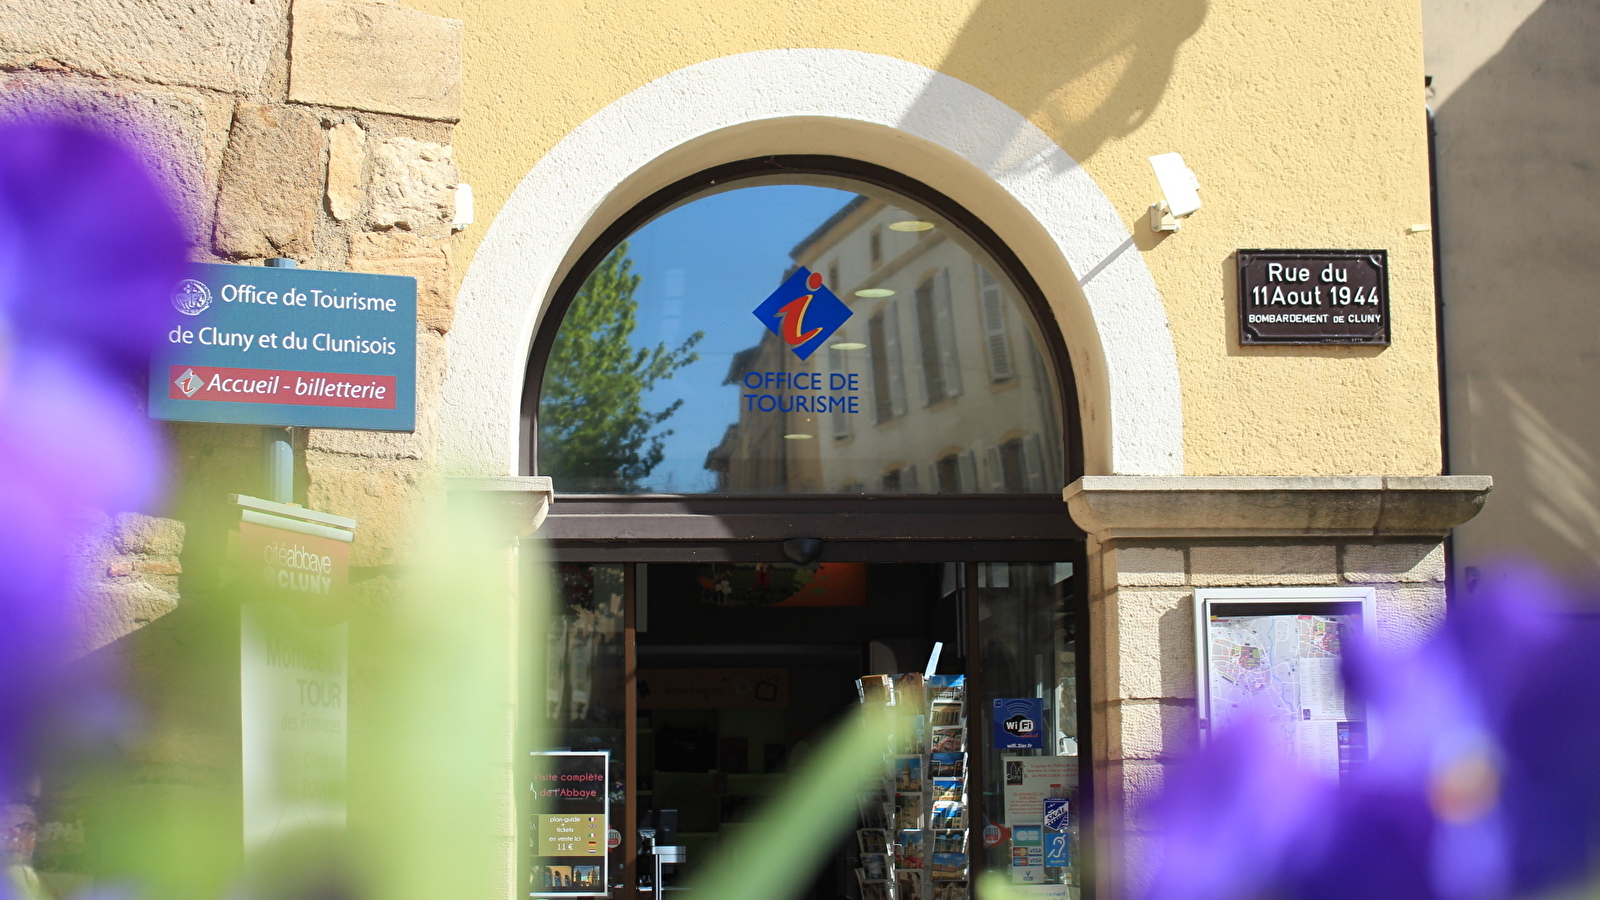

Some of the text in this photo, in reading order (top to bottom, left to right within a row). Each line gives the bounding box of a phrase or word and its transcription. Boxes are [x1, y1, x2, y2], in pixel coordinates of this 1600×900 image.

[1268, 262, 1347, 282] Rue du
[221, 284, 397, 312] Office de Tourisme
[1330, 286, 1379, 306] 1944
[1248, 314, 1381, 323] BOMBARDEMENT DE CLUNY
[168, 325, 396, 355] de Cluny et du Clunisois
[207, 373, 280, 394] Accueil
[295, 377, 386, 400] billetterie
[743, 371, 859, 391] OFFICE DE
[743, 394, 859, 414] TOURISME
[264, 540, 332, 576] citéabbaye
[277, 569, 332, 595] CLUNY
[296, 678, 341, 709] TOUR
[281, 711, 341, 738] des Fromages
[533, 772, 604, 783] Visite complète
[540, 788, 597, 799] de l'Abbaye
[567, 843, 574, 851] €
